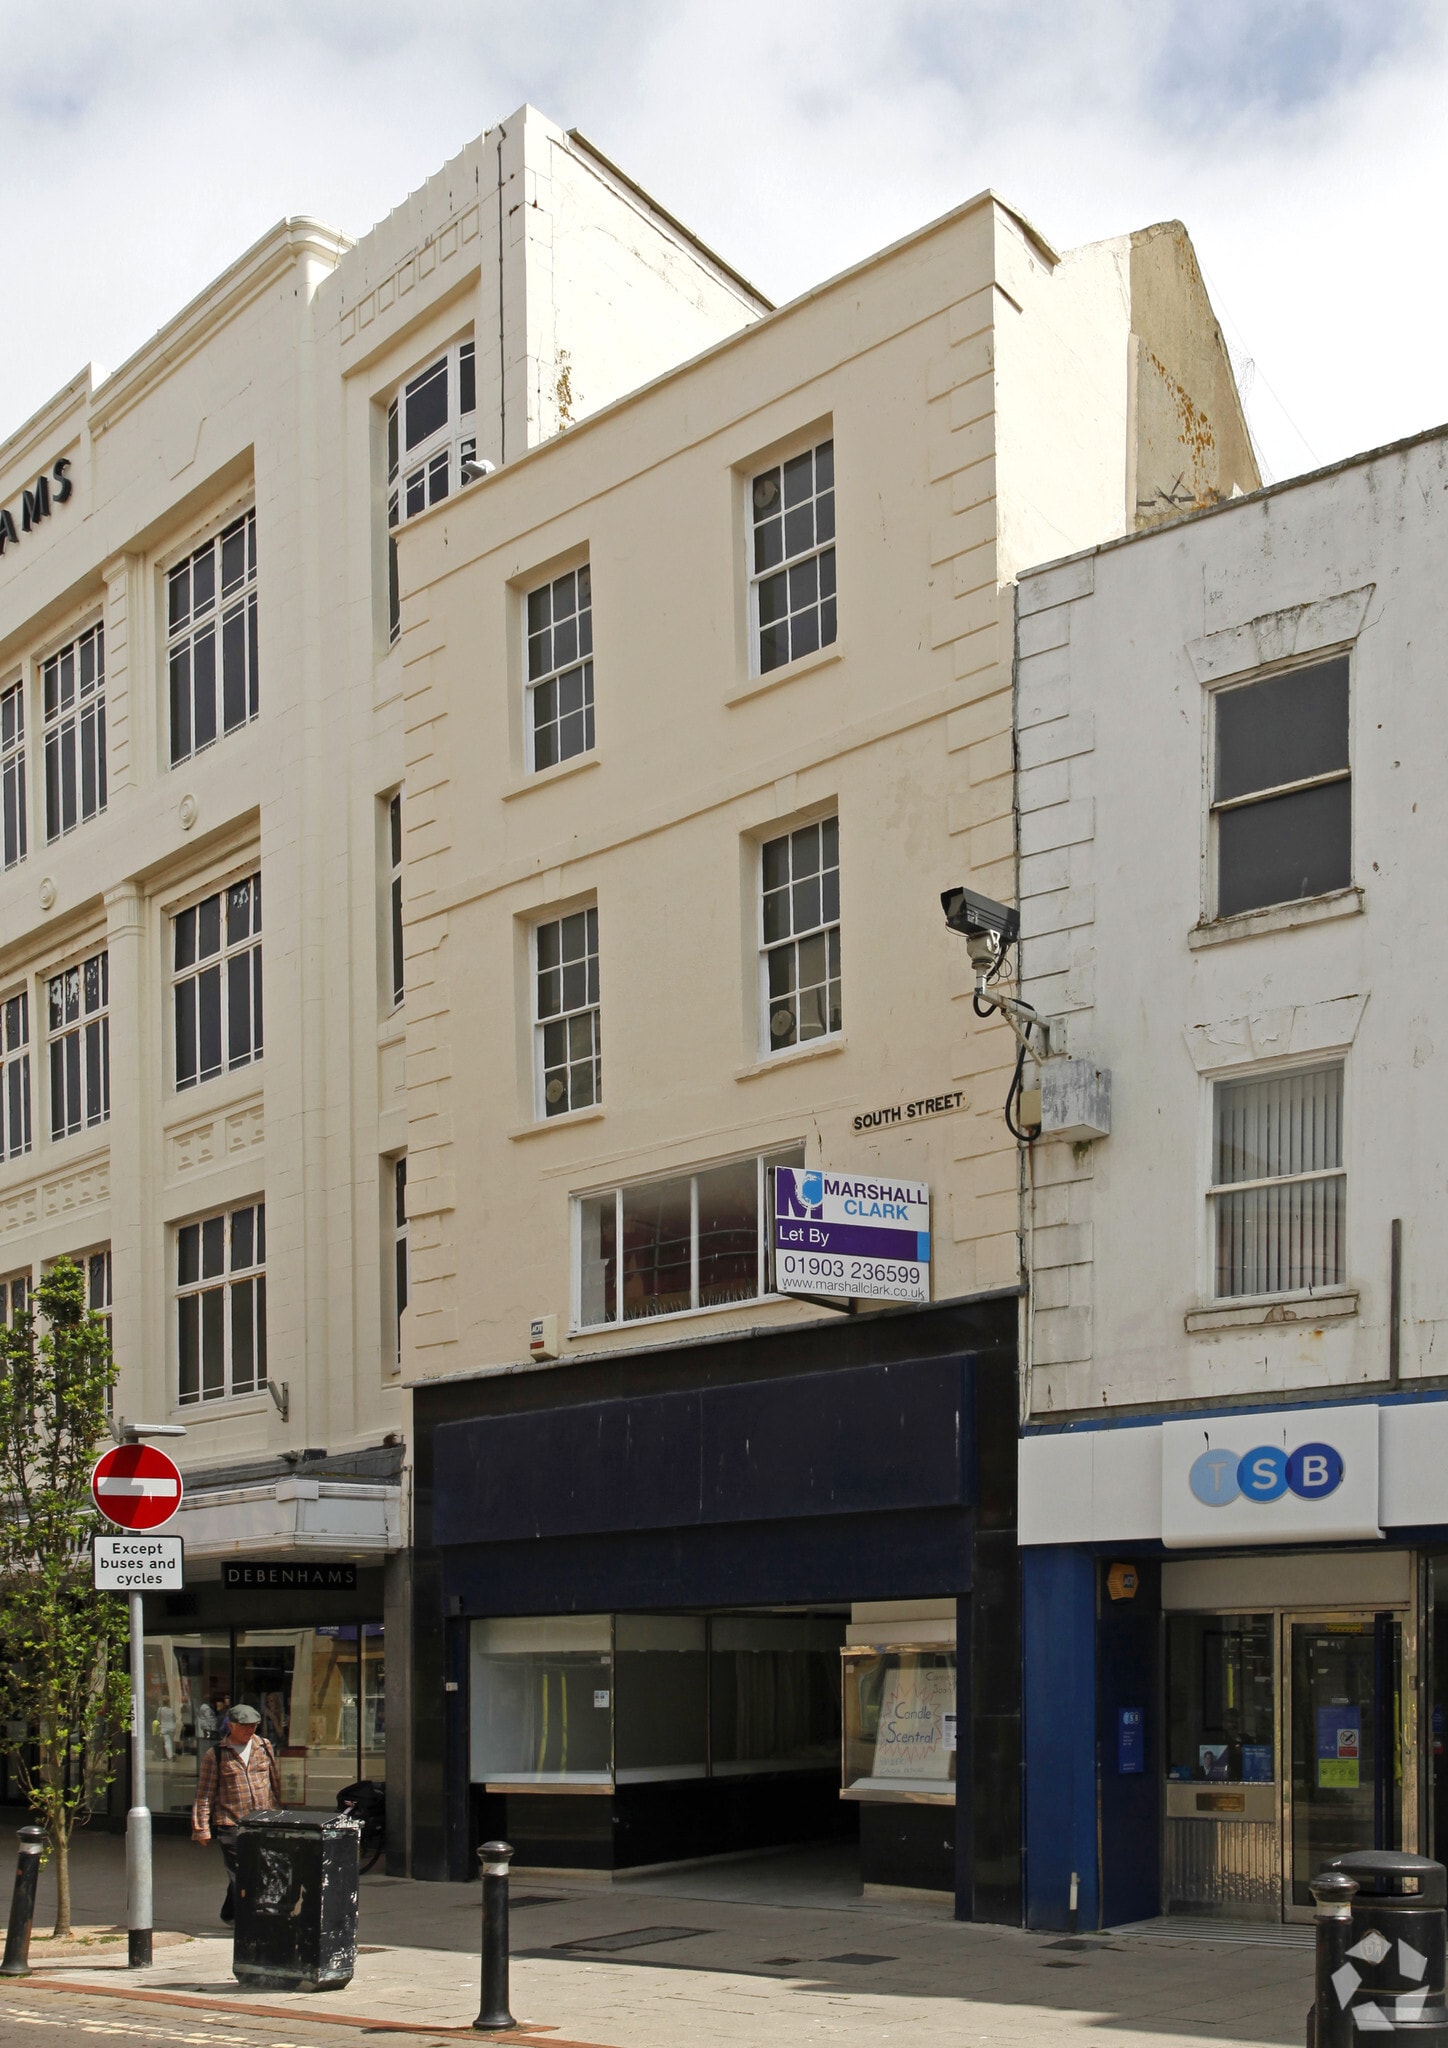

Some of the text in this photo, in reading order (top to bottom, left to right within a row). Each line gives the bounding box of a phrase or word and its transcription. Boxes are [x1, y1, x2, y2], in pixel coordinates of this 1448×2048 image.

[854, 1091, 963, 1130] SOUTH STREET
[824, 1179, 928, 1205] MARSHALL
[844, 1199, 909, 1221] CLARK
[779, 1225, 830, 1247] Let By
[784, 1255, 921, 1285] 01903 236599
[782, 1277, 925, 1299] www.marshallclark.co.uk
[1206, 1454, 1329, 1493] TSB
[112, 1542, 163, 1556] Except
[100, 1557, 176, 1569] buses and
[116, 1572, 163, 1586] cycles
[228, 1569, 354, 1583] DEBENHAMS
[895, 1701, 932, 1720] Candle
[886, 1721, 935, 1744] Scentral
